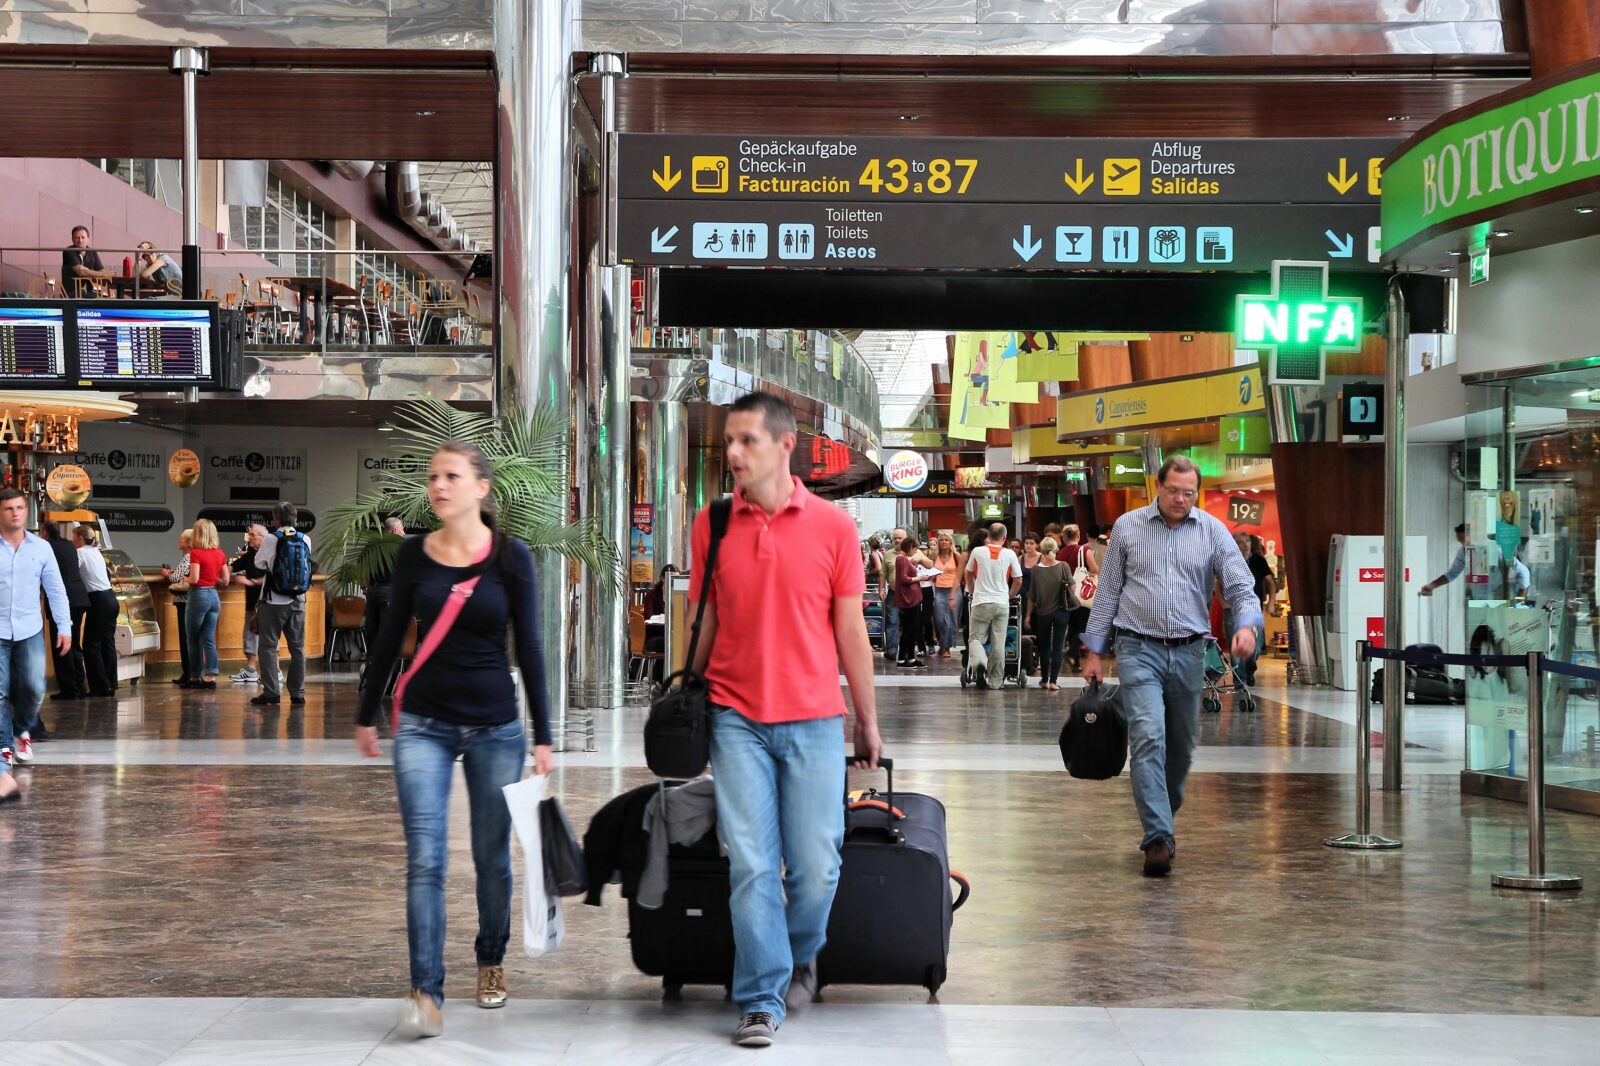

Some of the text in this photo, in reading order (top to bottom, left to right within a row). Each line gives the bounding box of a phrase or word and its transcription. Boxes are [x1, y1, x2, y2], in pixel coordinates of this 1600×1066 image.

[739, 139, 857, 158] Gepäckaufgabe
[1151, 142, 1202, 159] Abflug
[1422, 92, 1600, 218] BOTIQUI
[739, 157, 806, 173] Check-in
[1151, 159, 1236, 177] Departures
[738, 175, 850, 193] Facturación
[859, 159, 978, 194] 43 to 87
[913, 182, 923, 194] a
[1151, 177, 1220, 195] Salidas
[825, 208, 883, 222] Toiletten
[825, 225, 869, 240] Toilets
[825, 243, 877, 259] Aseos
[77, 310, 101, 318] Salidas
[74, 452, 107, 465] Caffè
[210, 455, 244, 468] Caffè
[890, 459, 922, 471] BURGER
[892, 466, 922, 481] KING
[1232, 503, 1250, 519] 19
[141, 519, 171, 527] ANKUNFT
